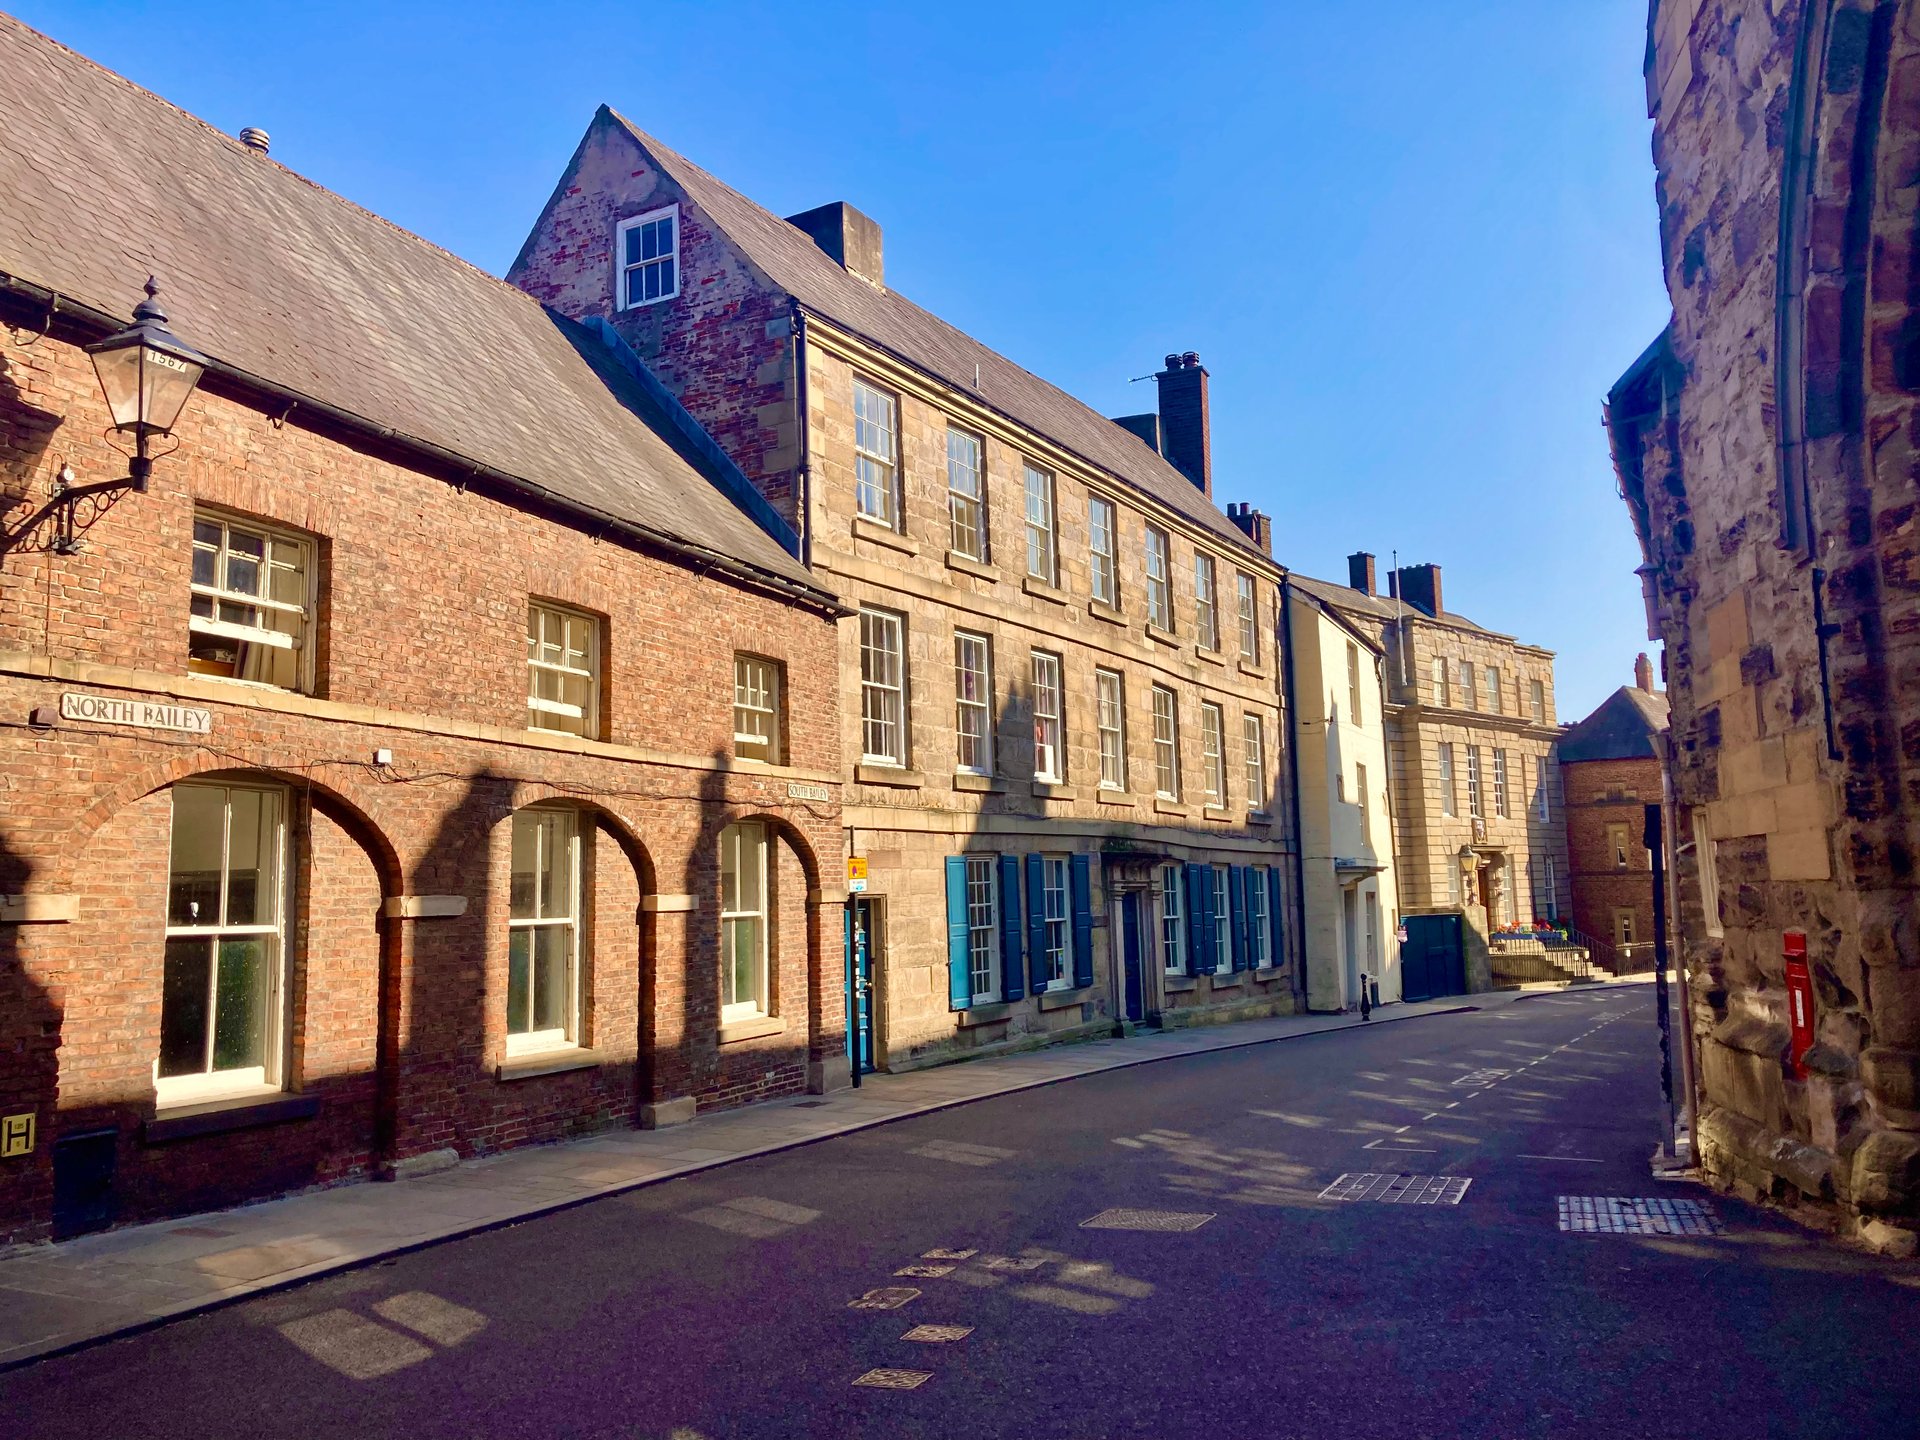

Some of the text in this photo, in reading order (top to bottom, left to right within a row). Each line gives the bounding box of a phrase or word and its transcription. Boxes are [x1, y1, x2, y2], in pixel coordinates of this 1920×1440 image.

[151, 352, 184, 370] 1567
[67, 696, 208, 730] NORTH BAILEY
[789, 785, 827, 799] SOUTH BAILEY
[7, 1119, 30, 1152] H
